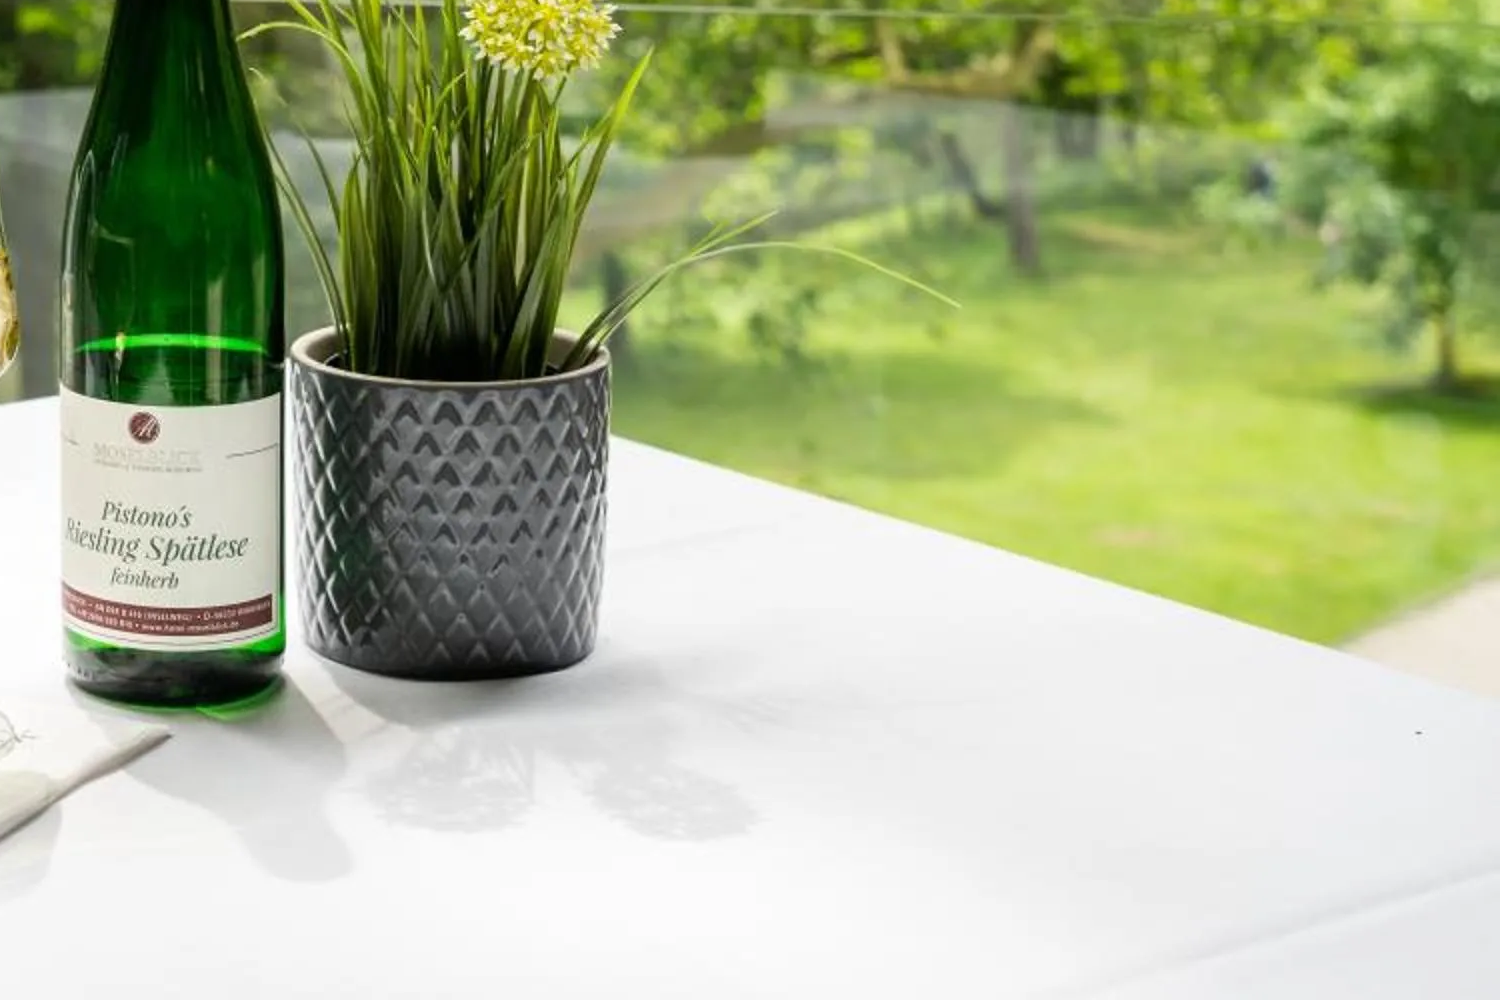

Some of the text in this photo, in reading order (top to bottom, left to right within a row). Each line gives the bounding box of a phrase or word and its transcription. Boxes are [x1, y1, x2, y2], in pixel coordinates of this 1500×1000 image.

[65, 517, 250, 567] Riesling Spätlese
[110, 566, 180, 590] feinherb
